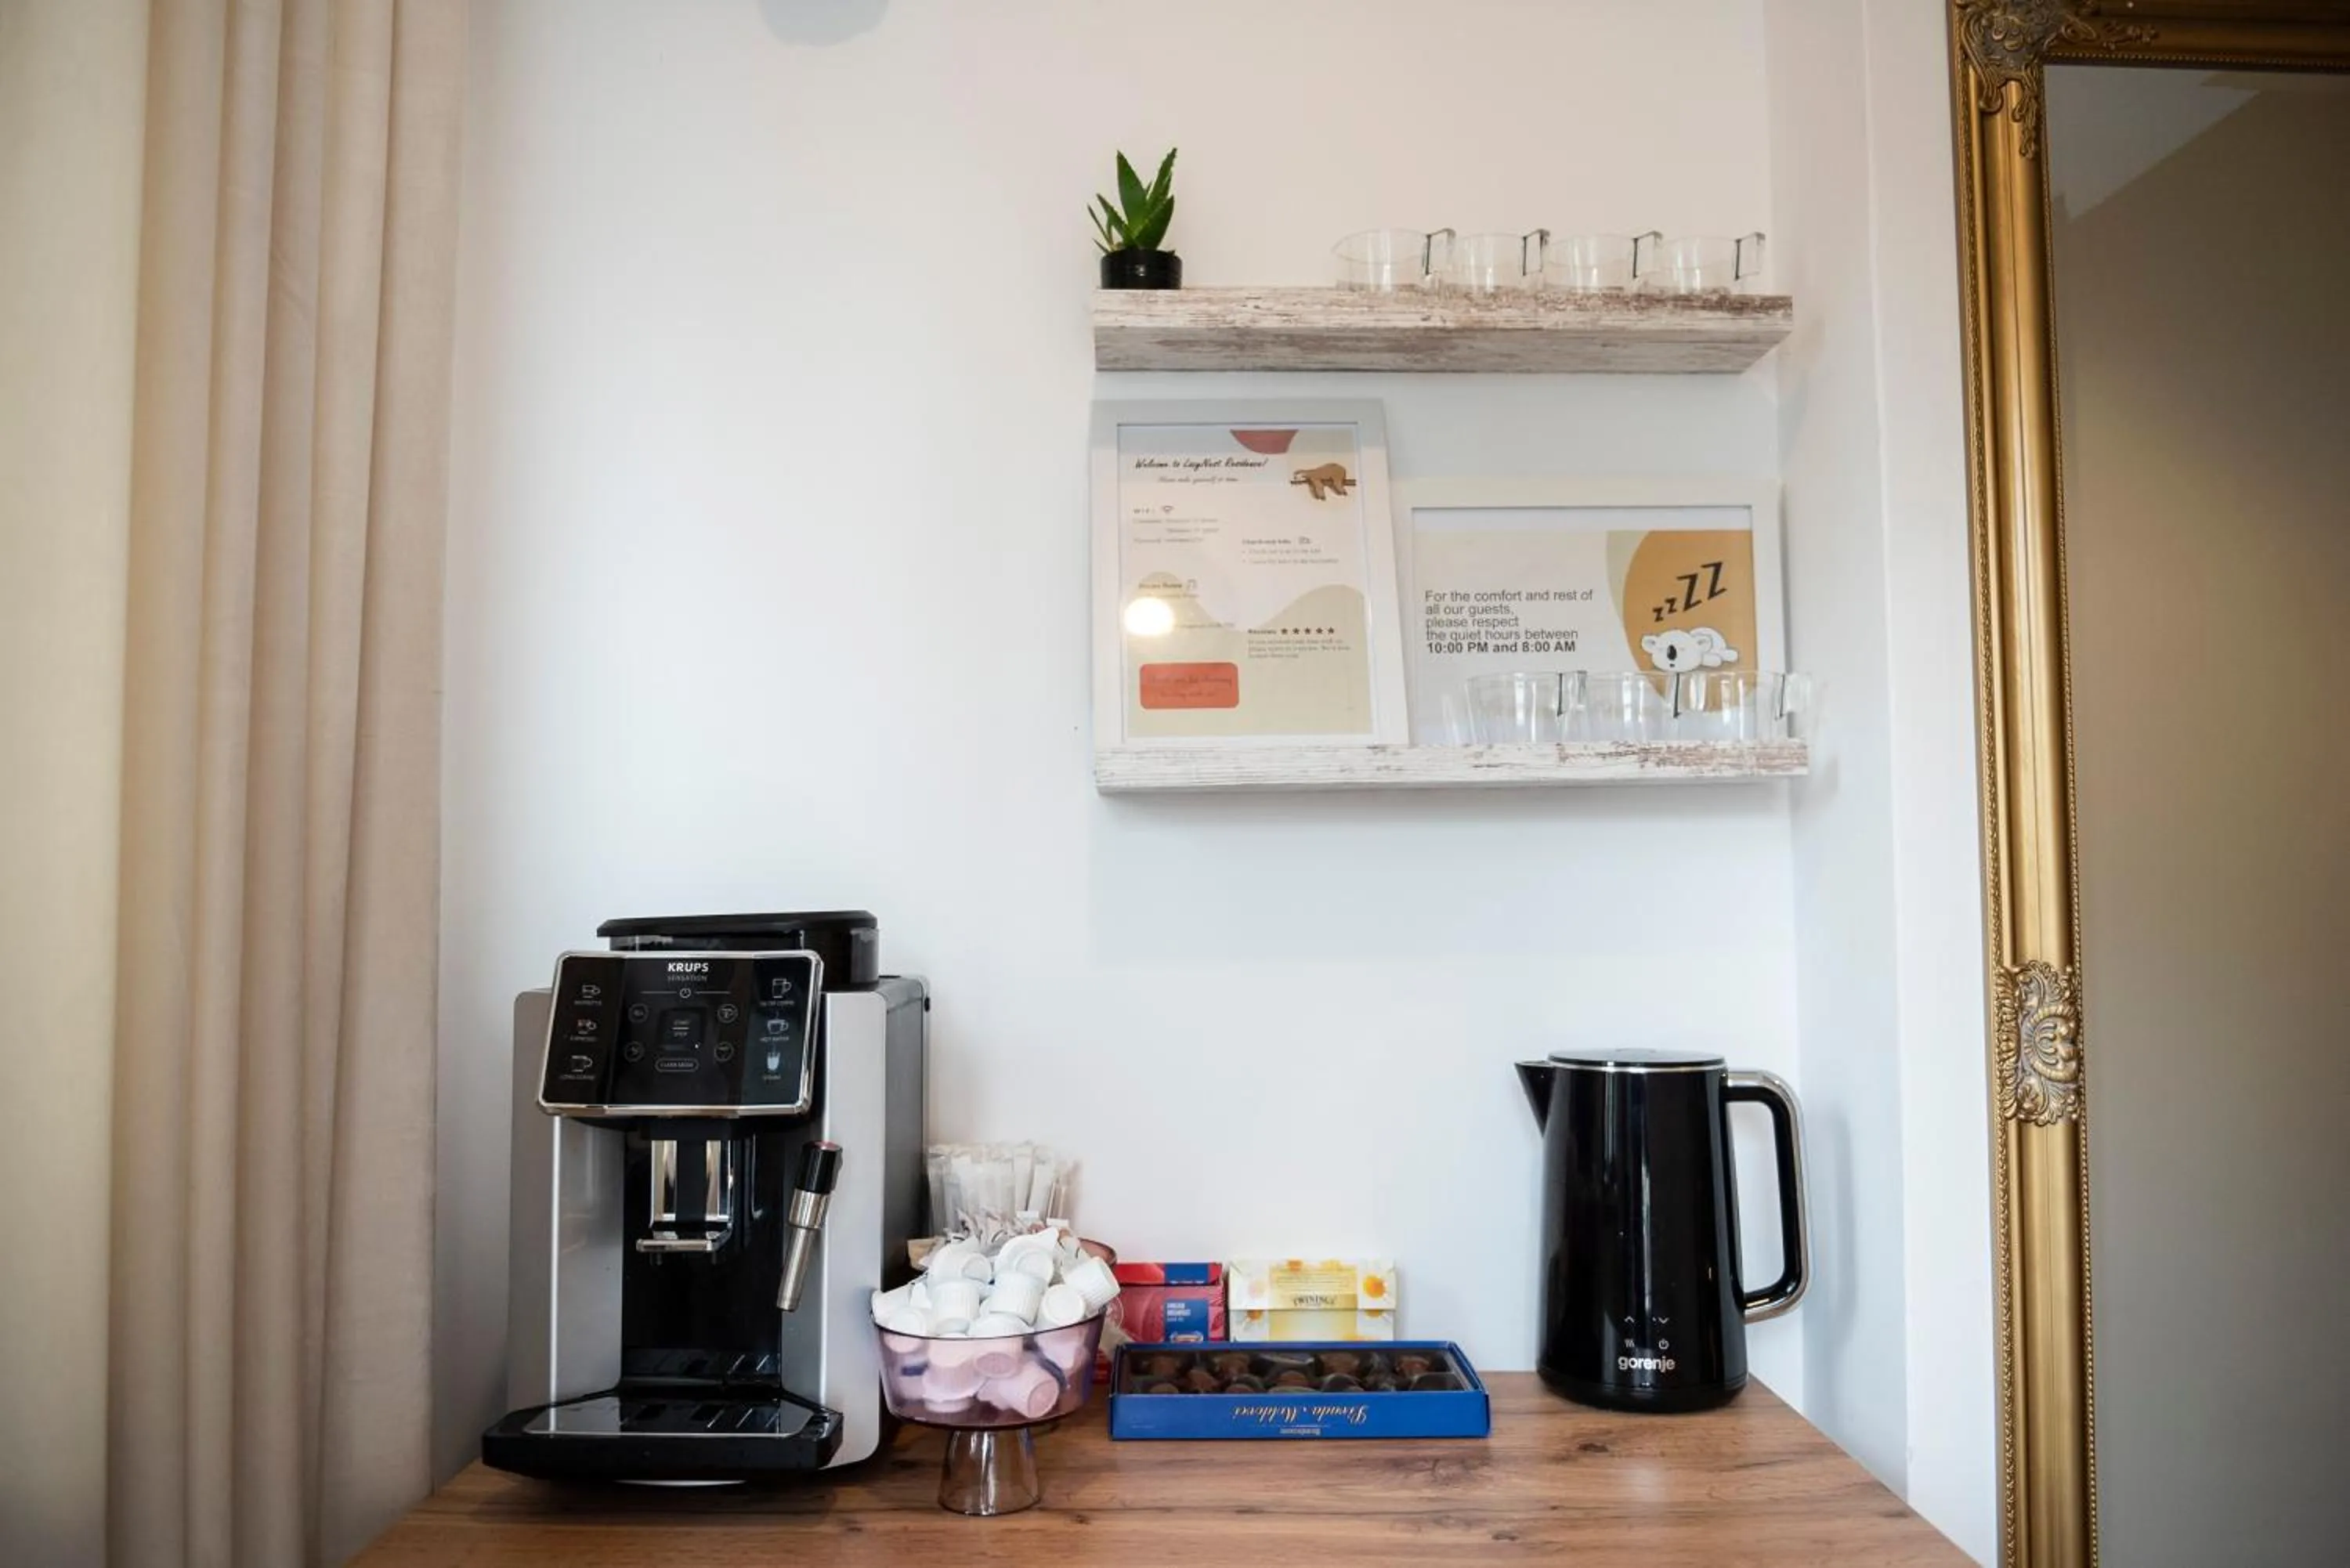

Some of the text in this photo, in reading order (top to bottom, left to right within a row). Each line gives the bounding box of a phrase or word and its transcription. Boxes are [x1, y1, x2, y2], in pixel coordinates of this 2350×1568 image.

[1425, 589, 1593, 602] For the comfort and rest of
[1425, 603, 1514, 617] all our guests,
[1426, 616, 1520, 630] please respect
[1426, 628, 1578, 642] the quiet hours between
[1427, 641, 1576, 653] 10:00 PM and 8:00 AM
[667, 963, 709, 972] KRUPS
[1618, 1356, 1676, 1373] gorenje
